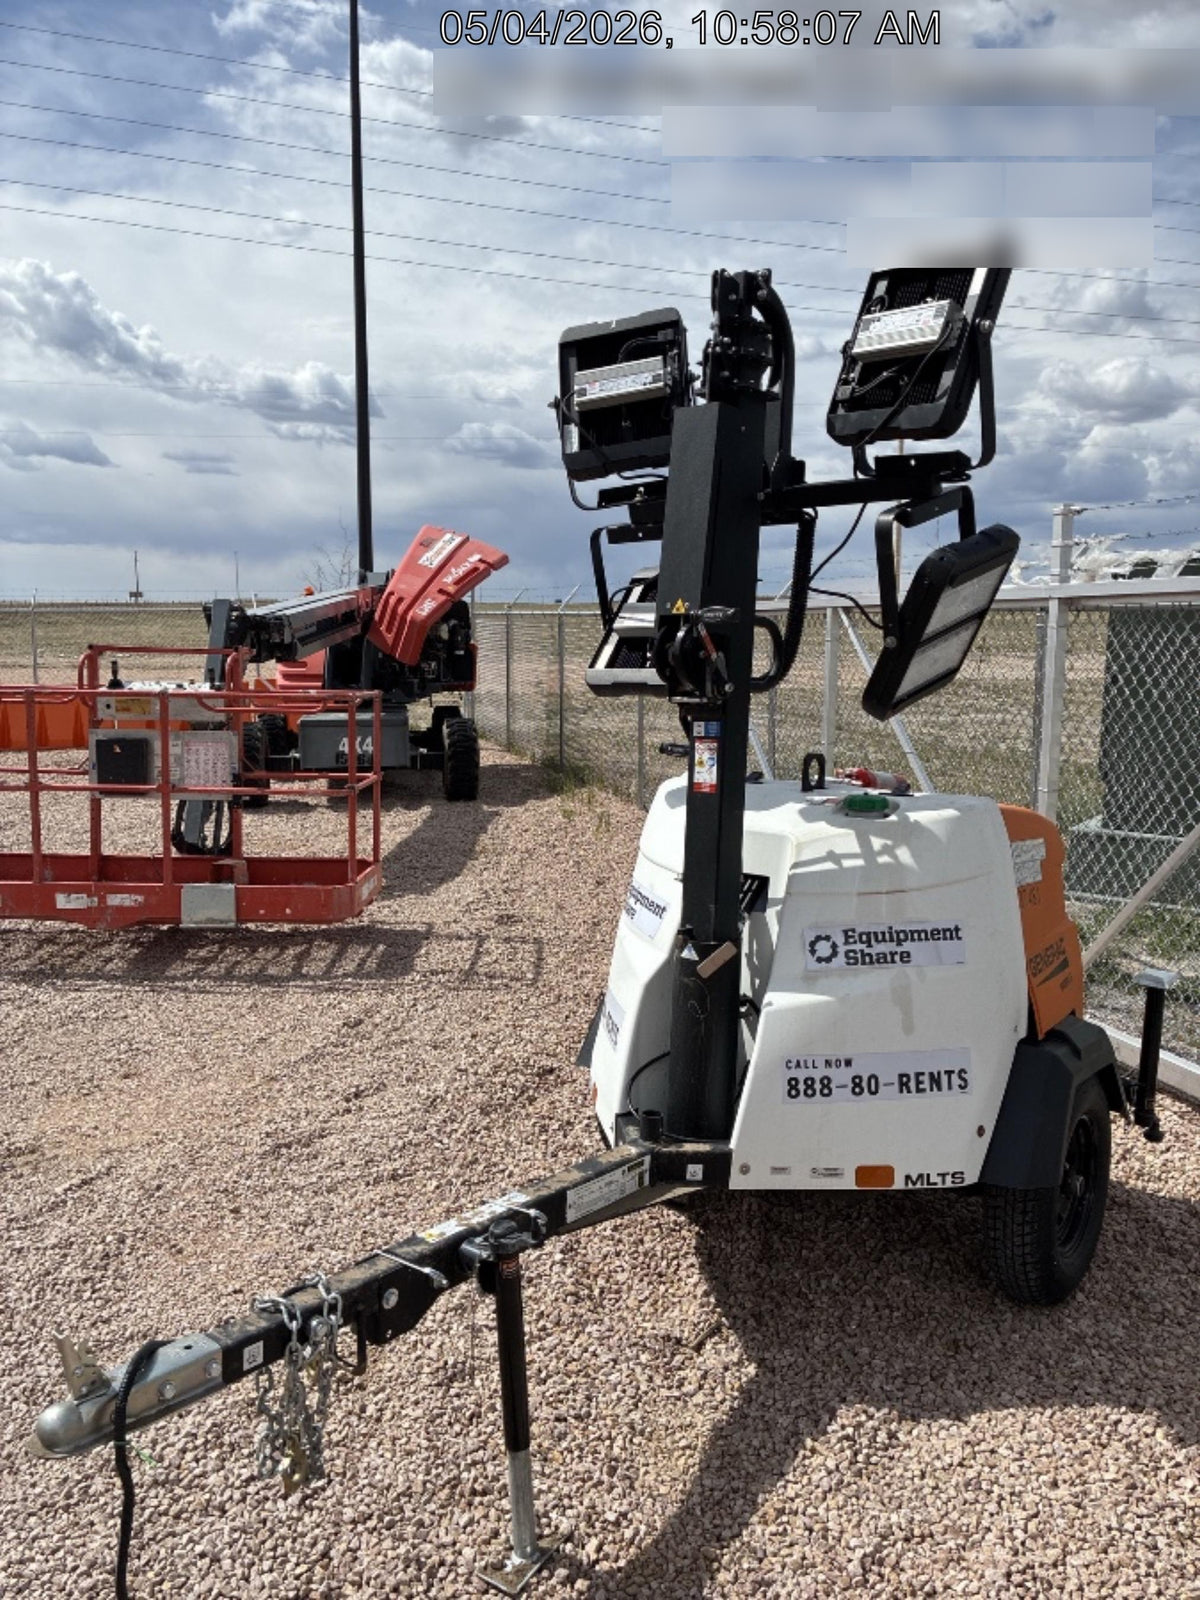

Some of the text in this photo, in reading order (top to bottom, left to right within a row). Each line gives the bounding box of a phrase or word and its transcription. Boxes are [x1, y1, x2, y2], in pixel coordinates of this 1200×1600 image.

[842, 925, 962, 948] Equipment
[844, 949, 912, 966] Share
[785, 1058, 854, 1070] CALL NOW
[786, 1068, 969, 1099] 888-80-RENTS
[904, 1171, 965, 1188] MLTS
